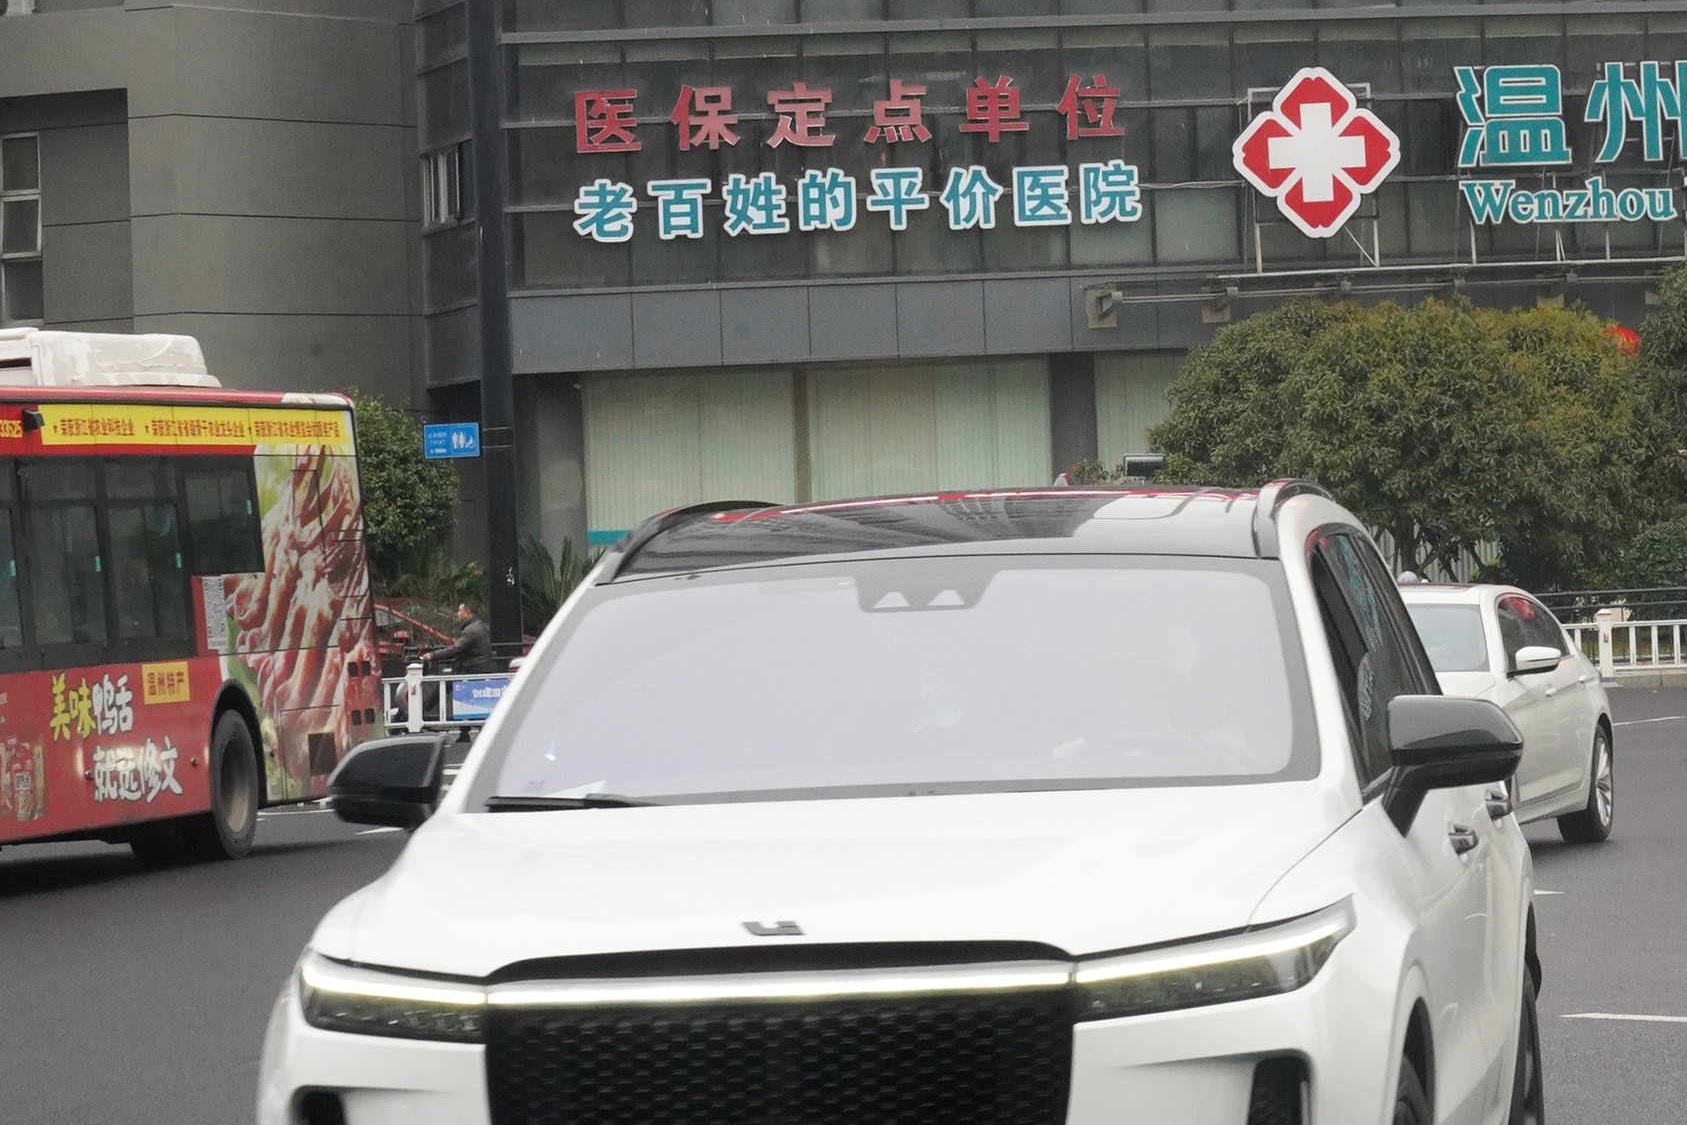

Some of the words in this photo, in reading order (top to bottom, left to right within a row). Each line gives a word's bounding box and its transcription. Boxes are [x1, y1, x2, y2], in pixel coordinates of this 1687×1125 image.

[574, 75, 1126, 153] 医保定点单位
[573, 159, 1143, 243] 老百姓的平价医院
[1459, 175, 1678, 226] Wenzhou
[50, 672, 134, 742] 美味鸭舌
